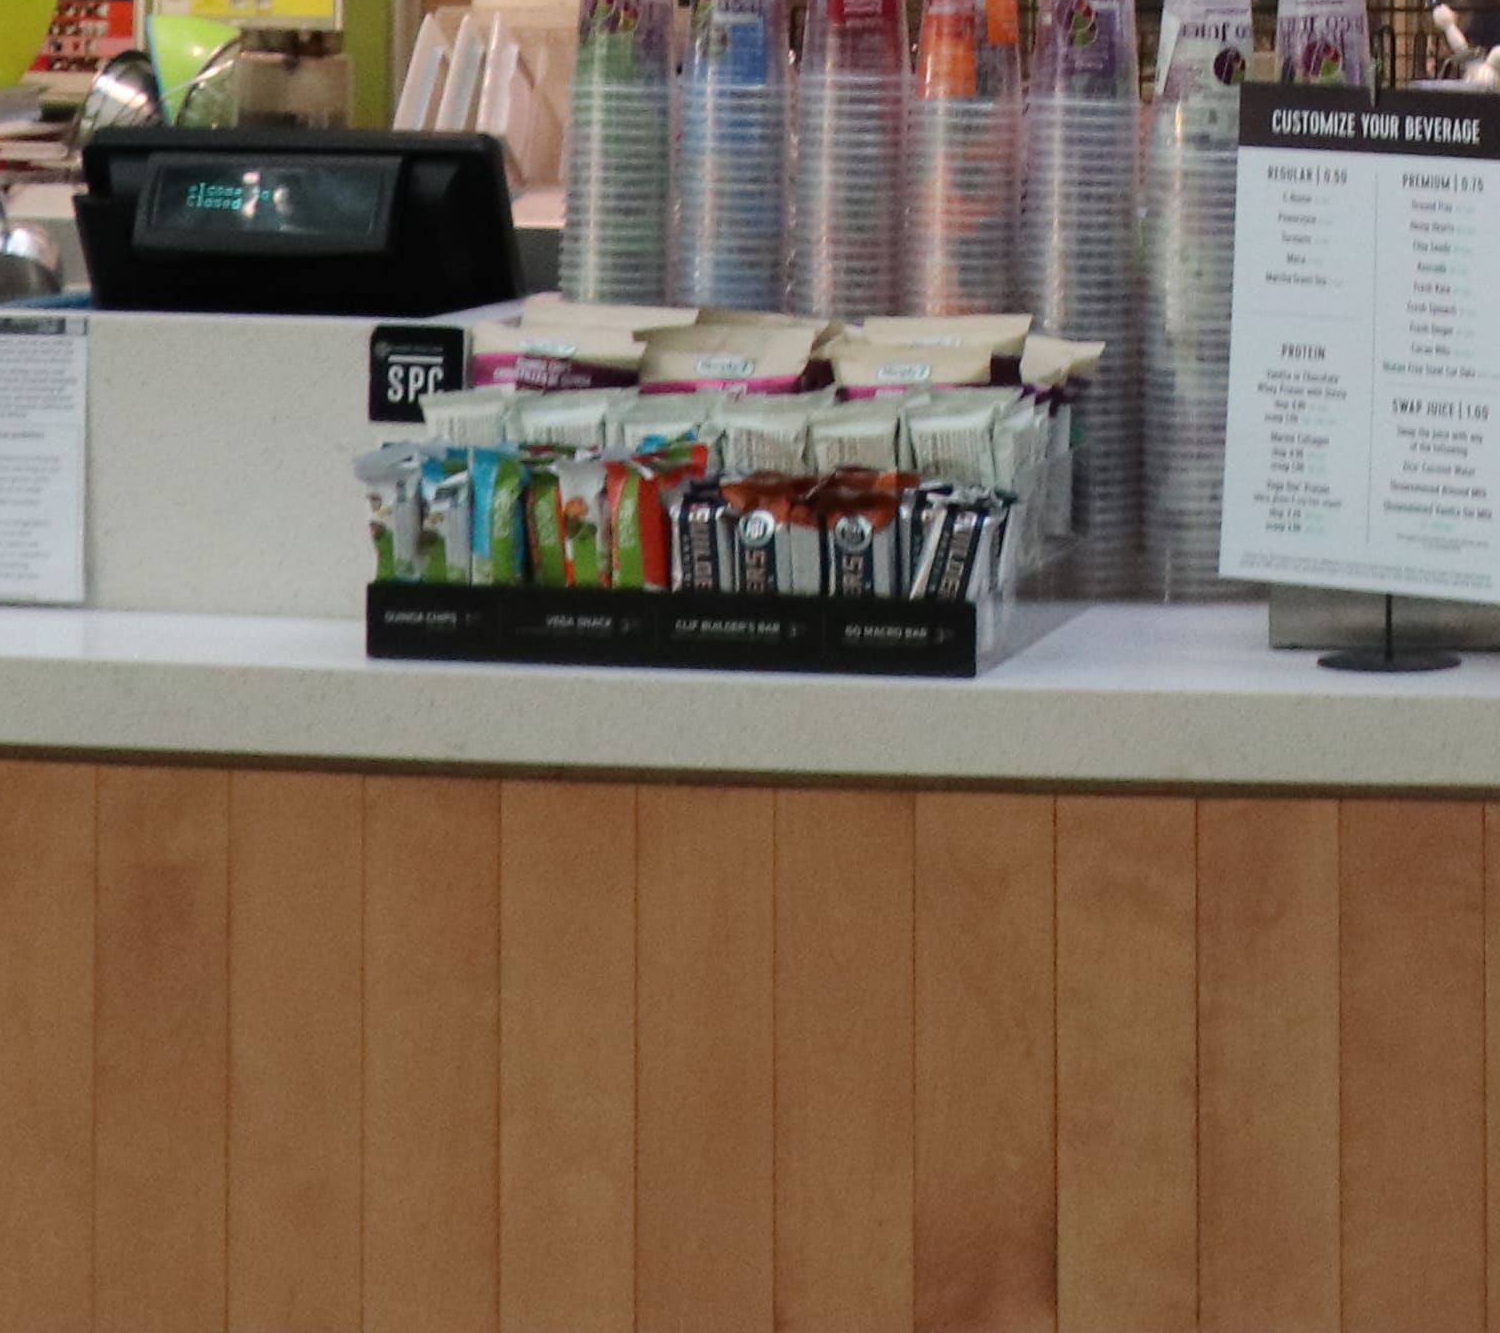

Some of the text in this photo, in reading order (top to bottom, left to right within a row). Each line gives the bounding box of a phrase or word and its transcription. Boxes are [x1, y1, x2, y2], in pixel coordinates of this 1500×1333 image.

[1272, 109, 1481, 145] CUSTOMIZE YOUR BEVERAGE
[1267, 166, 1313, 182] REGULAR
[1402, 173, 1450, 189] PREMIUM
[1282, 343, 1326, 360] PROTEIN
[1392, 399, 1454, 419] SWAP JUICE
